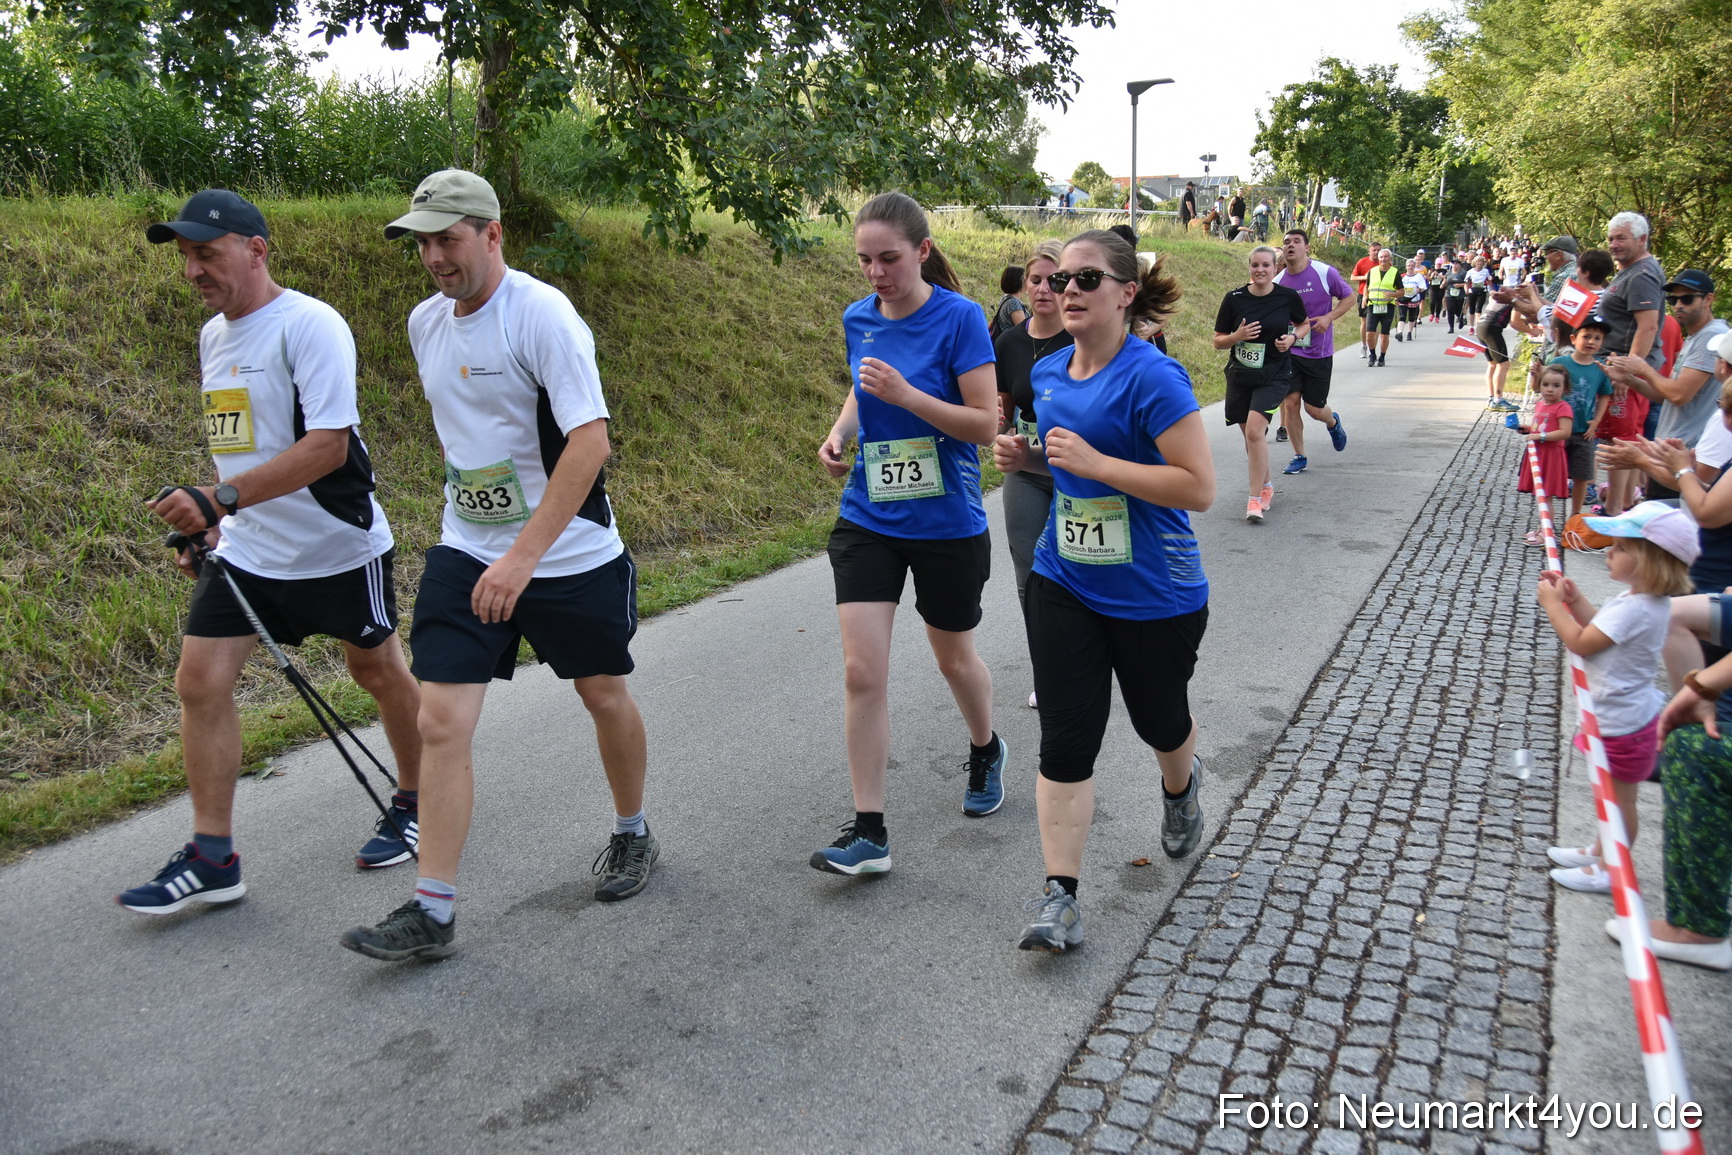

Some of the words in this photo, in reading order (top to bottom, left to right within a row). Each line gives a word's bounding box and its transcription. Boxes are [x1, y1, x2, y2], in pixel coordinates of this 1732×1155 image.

[1237, 347, 1260, 361] 1863
[881, 460, 923, 485] 573
[908, 481, 935, 489] Michaela
[452, 484, 512, 510] 2383
[1065, 519, 1105, 546] 571
